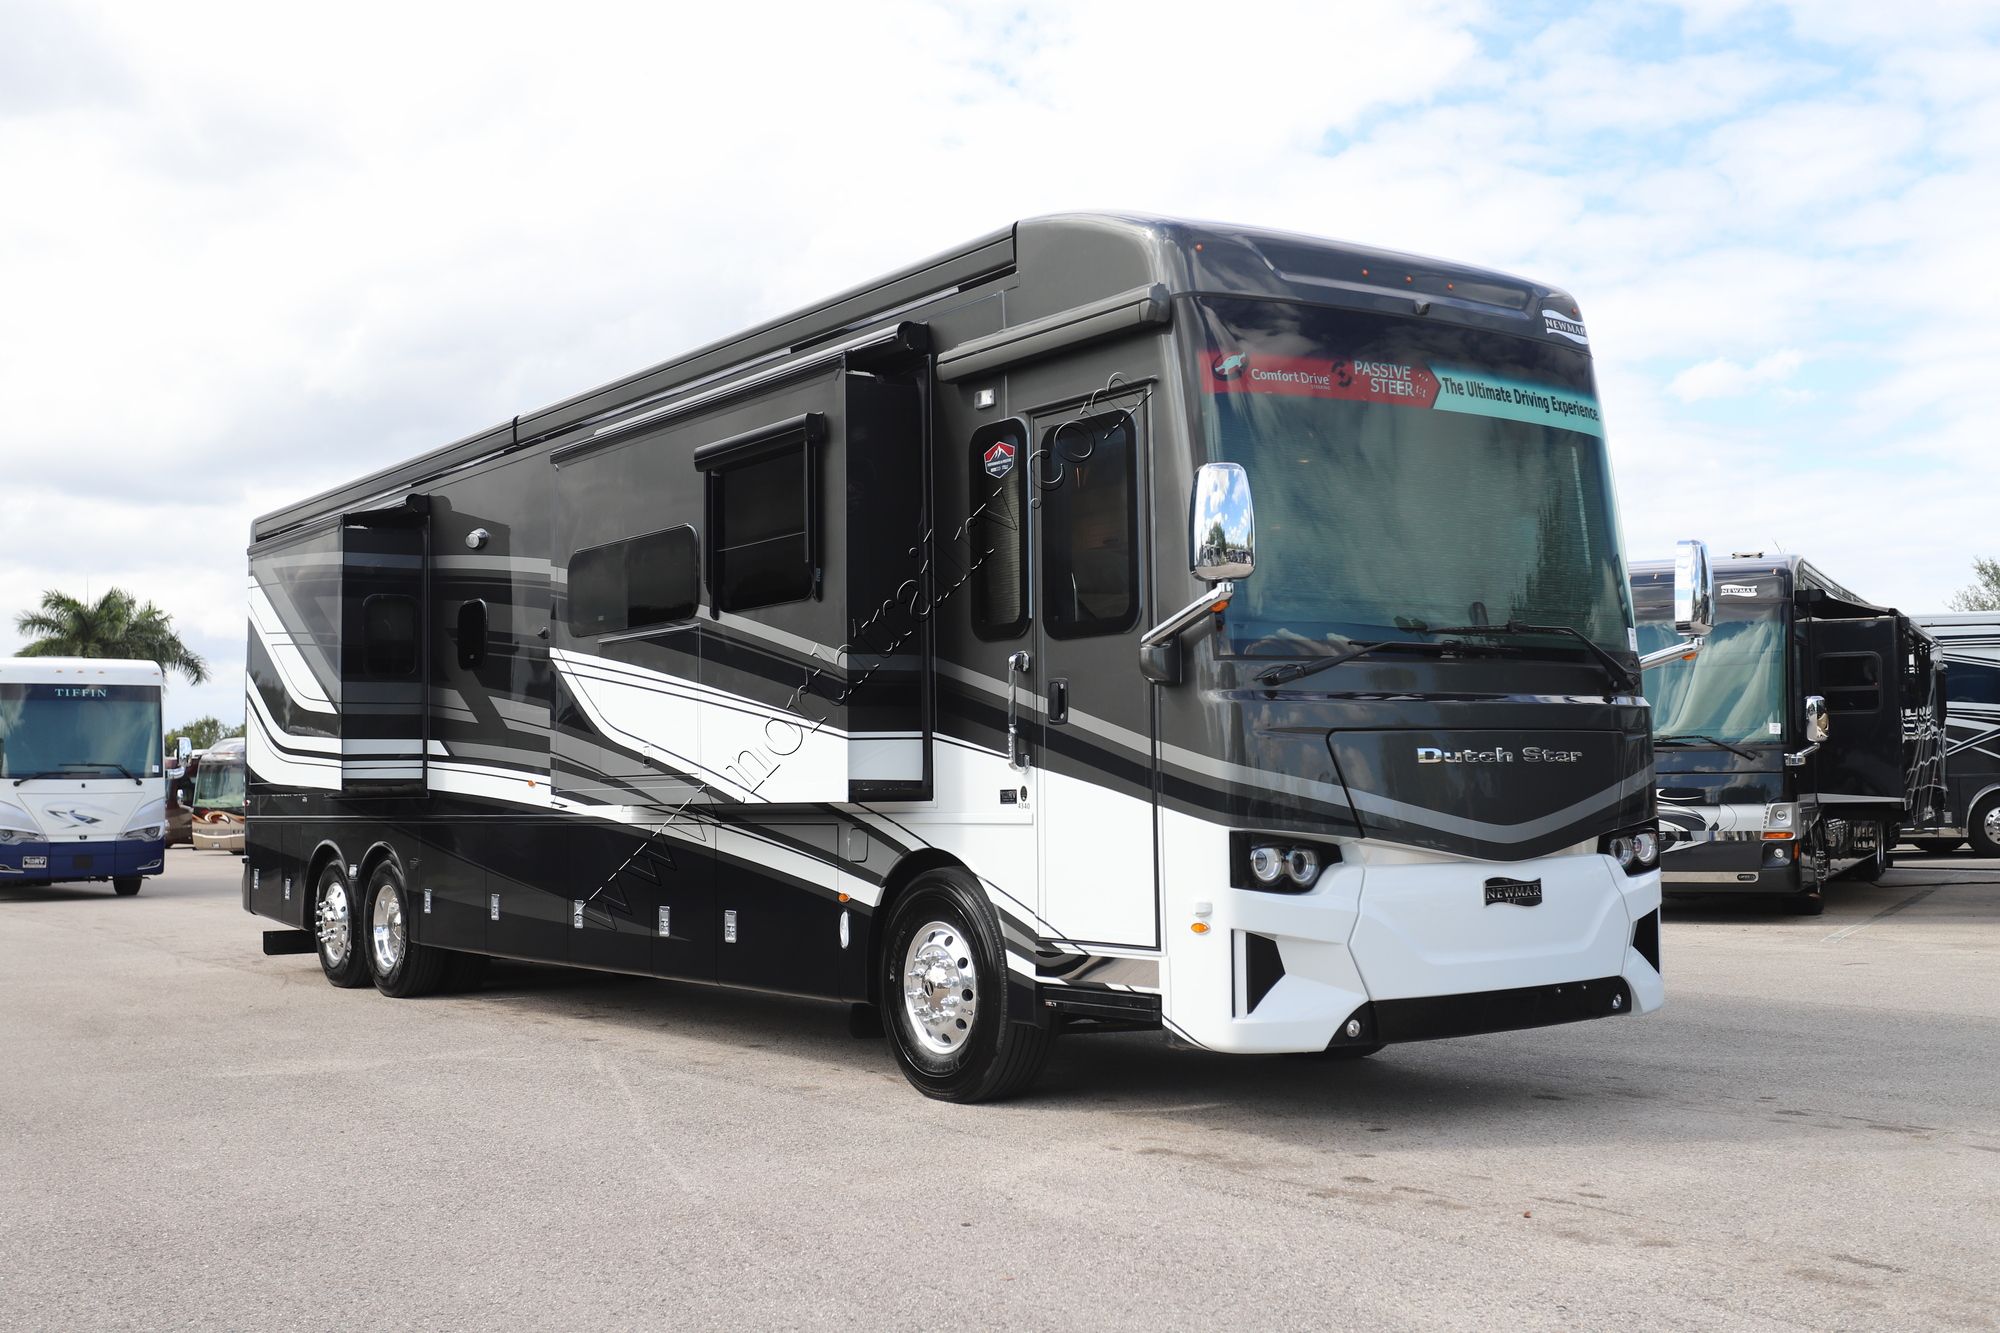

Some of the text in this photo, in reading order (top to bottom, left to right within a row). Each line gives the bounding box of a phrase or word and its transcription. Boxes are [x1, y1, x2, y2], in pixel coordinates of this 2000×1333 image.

[1251, 368, 1330, 385] Comfort Drive
[1354, 360, 1411, 381] PASSIVE
[1370, 378, 1414, 397] STEER
[1442, 377, 1464, 396] The
[1466, 380, 1512, 404] Ultimate
[1513, 388, 1550, 414] Driving
[54, 688, 107, 698] TIFFIN
[1416, 746, 1583, 764] Dutch Star
[1486, 885, 1541, 899] NEWMAR
